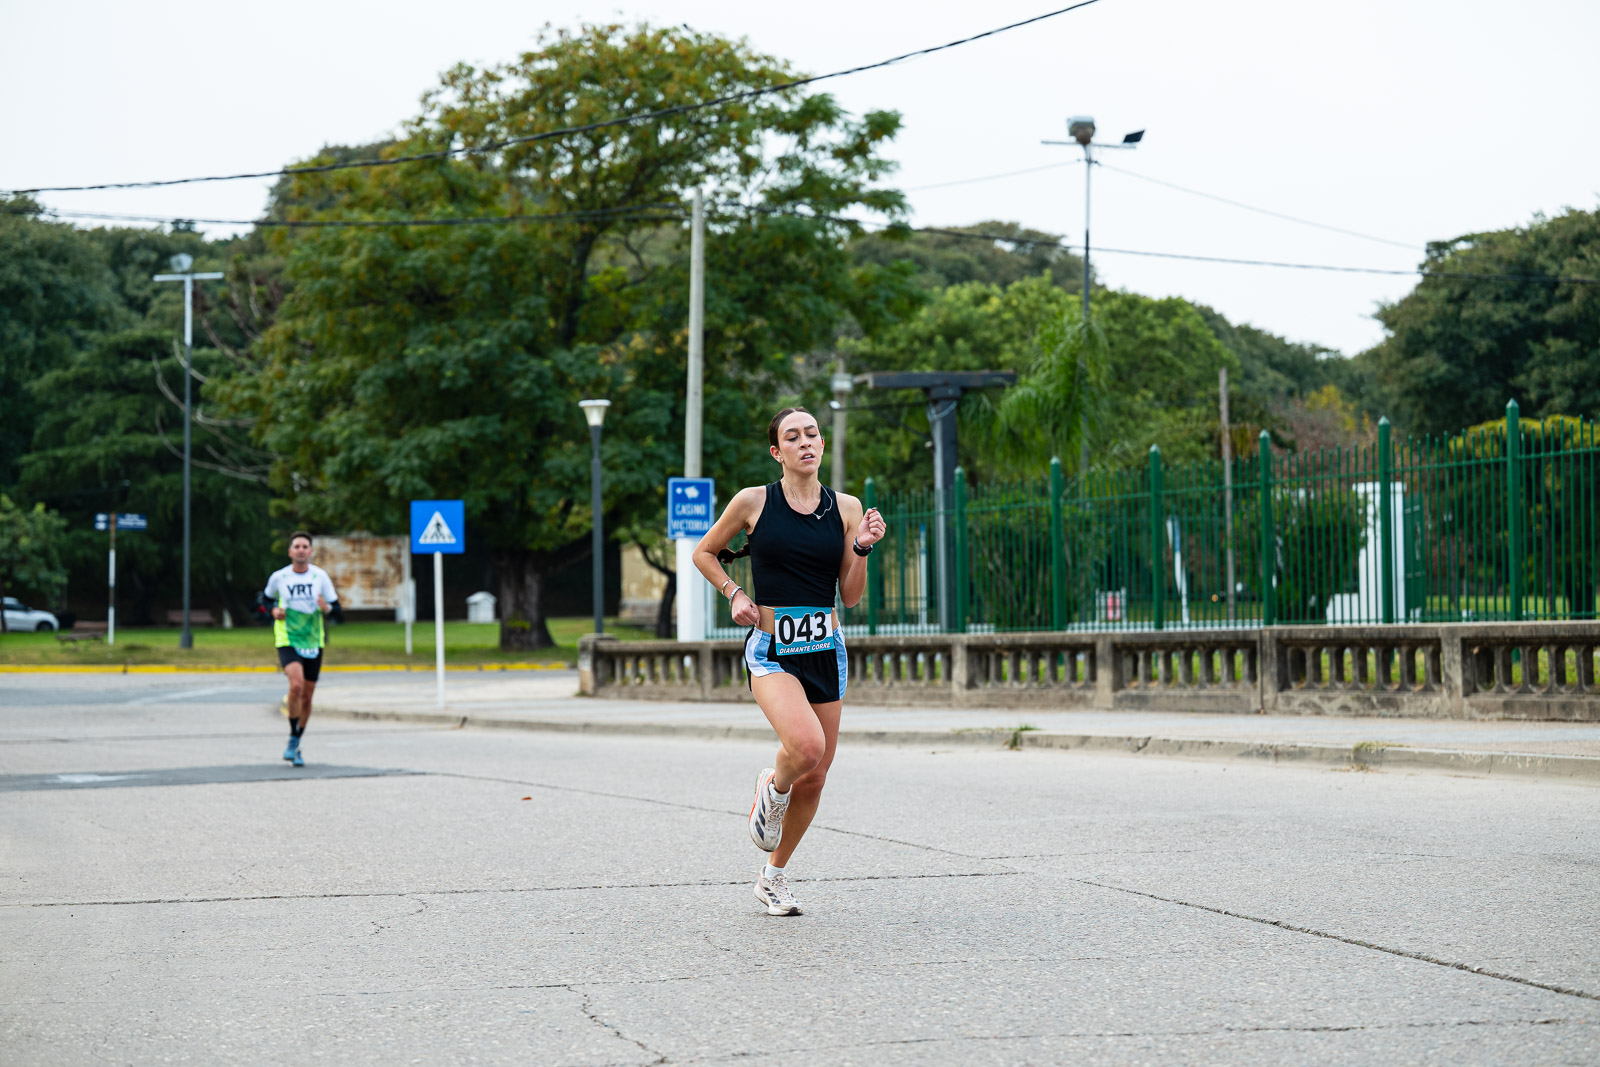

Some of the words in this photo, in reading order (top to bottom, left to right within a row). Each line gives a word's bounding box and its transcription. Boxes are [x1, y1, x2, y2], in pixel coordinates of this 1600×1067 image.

[675, 503, 706, 516] CASINO
[672, 520, 709, 531] VICTORIA
[778, 611, 827, 646] 043
[779, 645, 811, 654] DIAMANTE
[811, 642, 831, 651] CORRE
